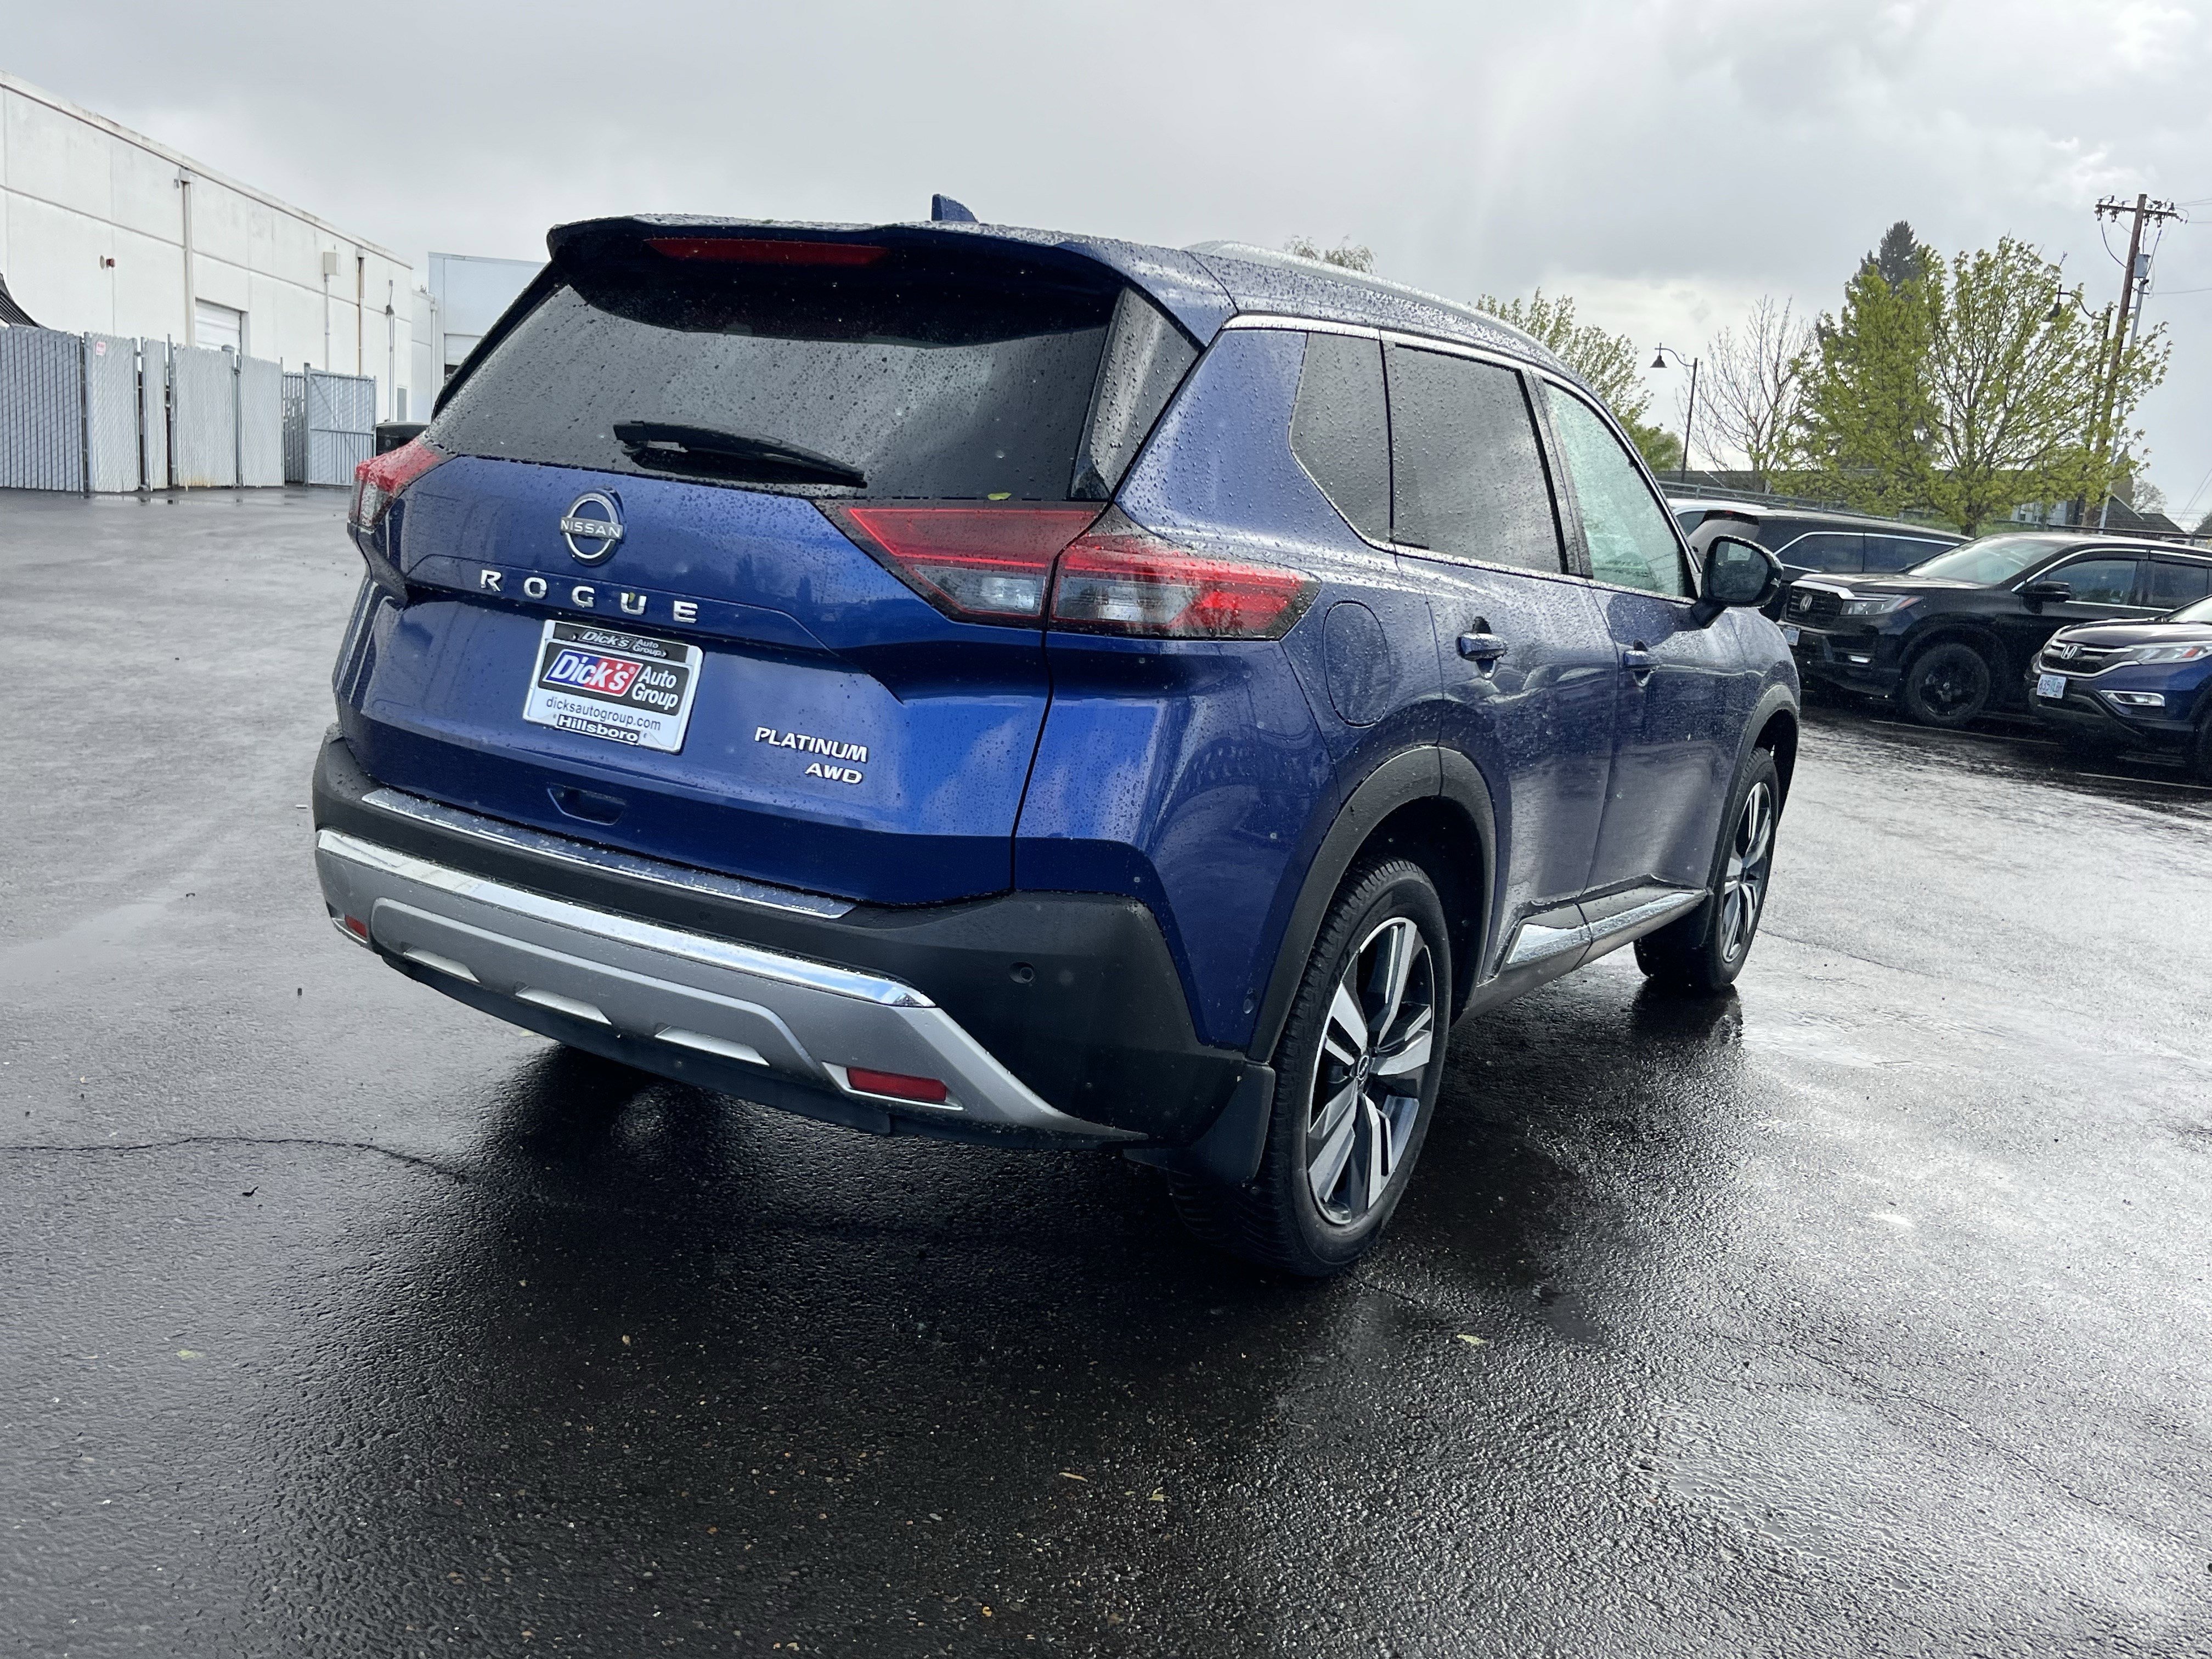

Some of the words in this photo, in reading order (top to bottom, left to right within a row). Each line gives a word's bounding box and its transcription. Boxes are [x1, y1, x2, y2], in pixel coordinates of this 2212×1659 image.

[561, 519, 620, 538] NISSAN
[481, 569, 698, 623] ROGUE
[582, 630, 630, 647] Dick's
[635, 639, 659, 649] Auto
[551, 655, 629, 692] Dick's
[637, 666, 677, 689] Auto
[631, 682, 679, 710] Group
[546, 696, 661, 731] dicksautogroup.com
[557, 715, 639, 742] Hillsboro
[754, 726, 868, 763] PLATINUM
[804, 762, 864, 785] AWD
